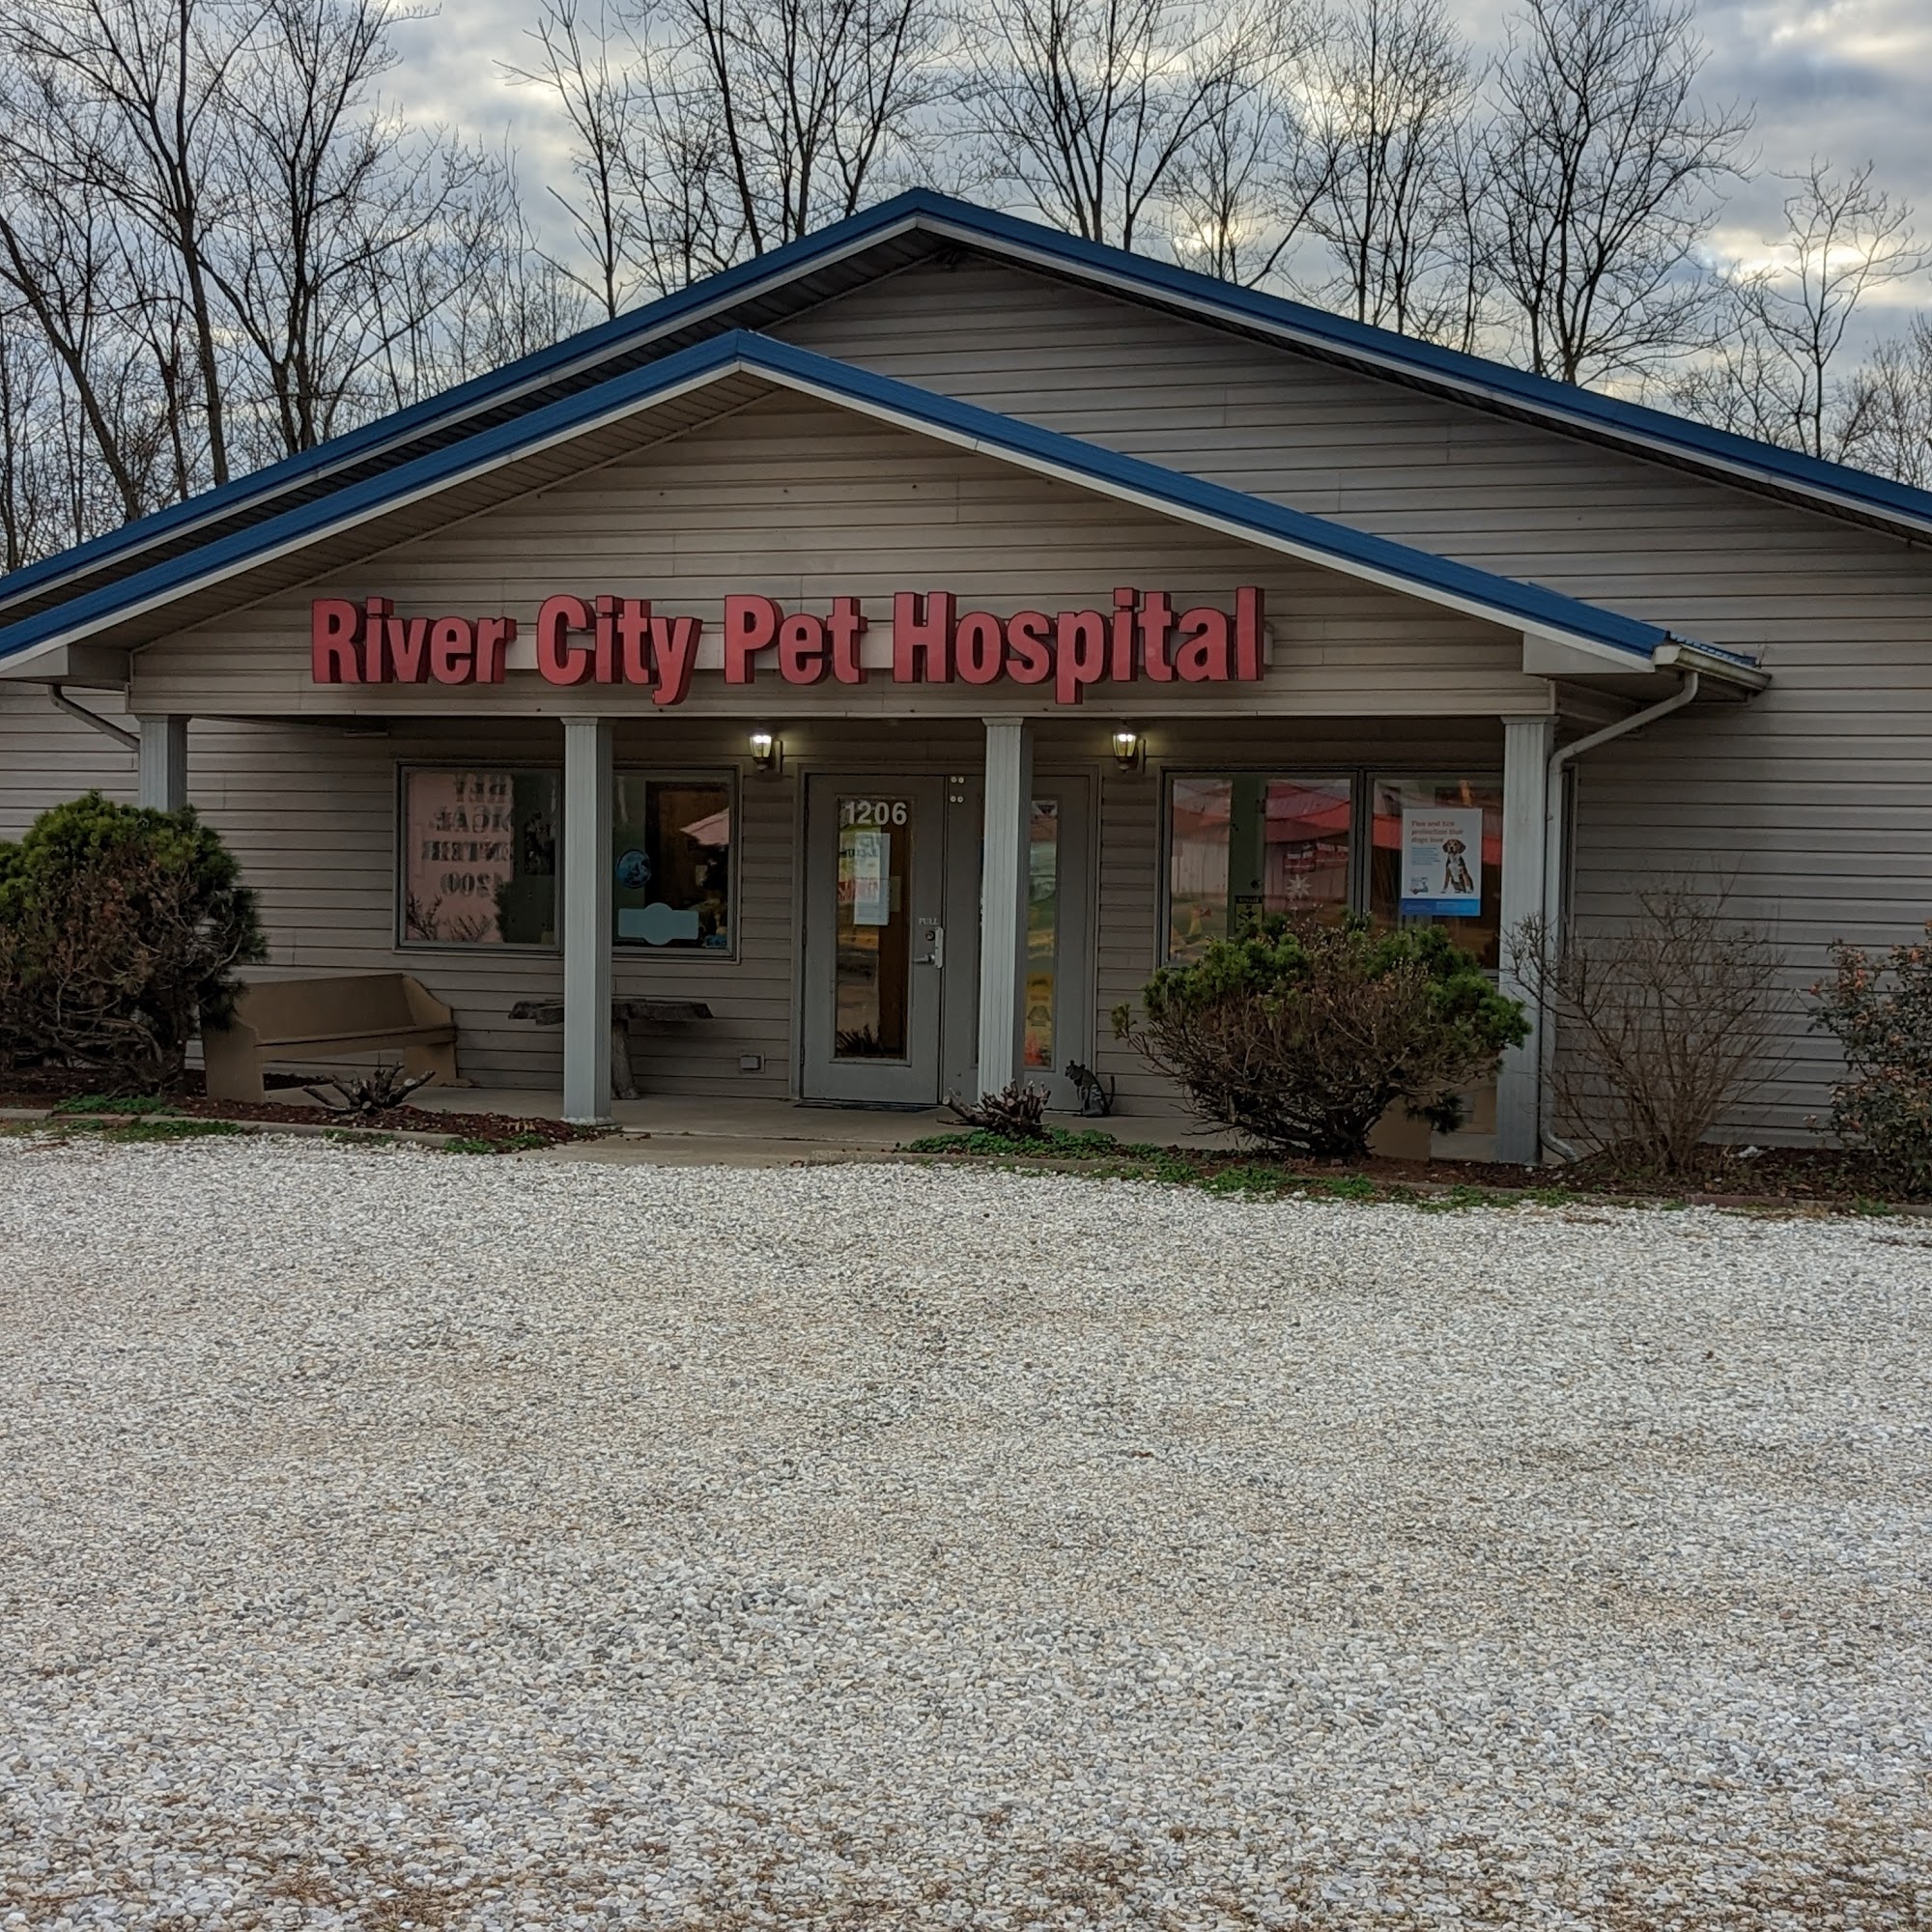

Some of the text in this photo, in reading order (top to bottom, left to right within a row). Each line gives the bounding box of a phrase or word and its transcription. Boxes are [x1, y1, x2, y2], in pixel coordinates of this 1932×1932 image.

[312, 586, 1264, 705] River City Pet Hospital
[845, 801, 907, 826] 1206
[919, 917, 939, 925] PULL
